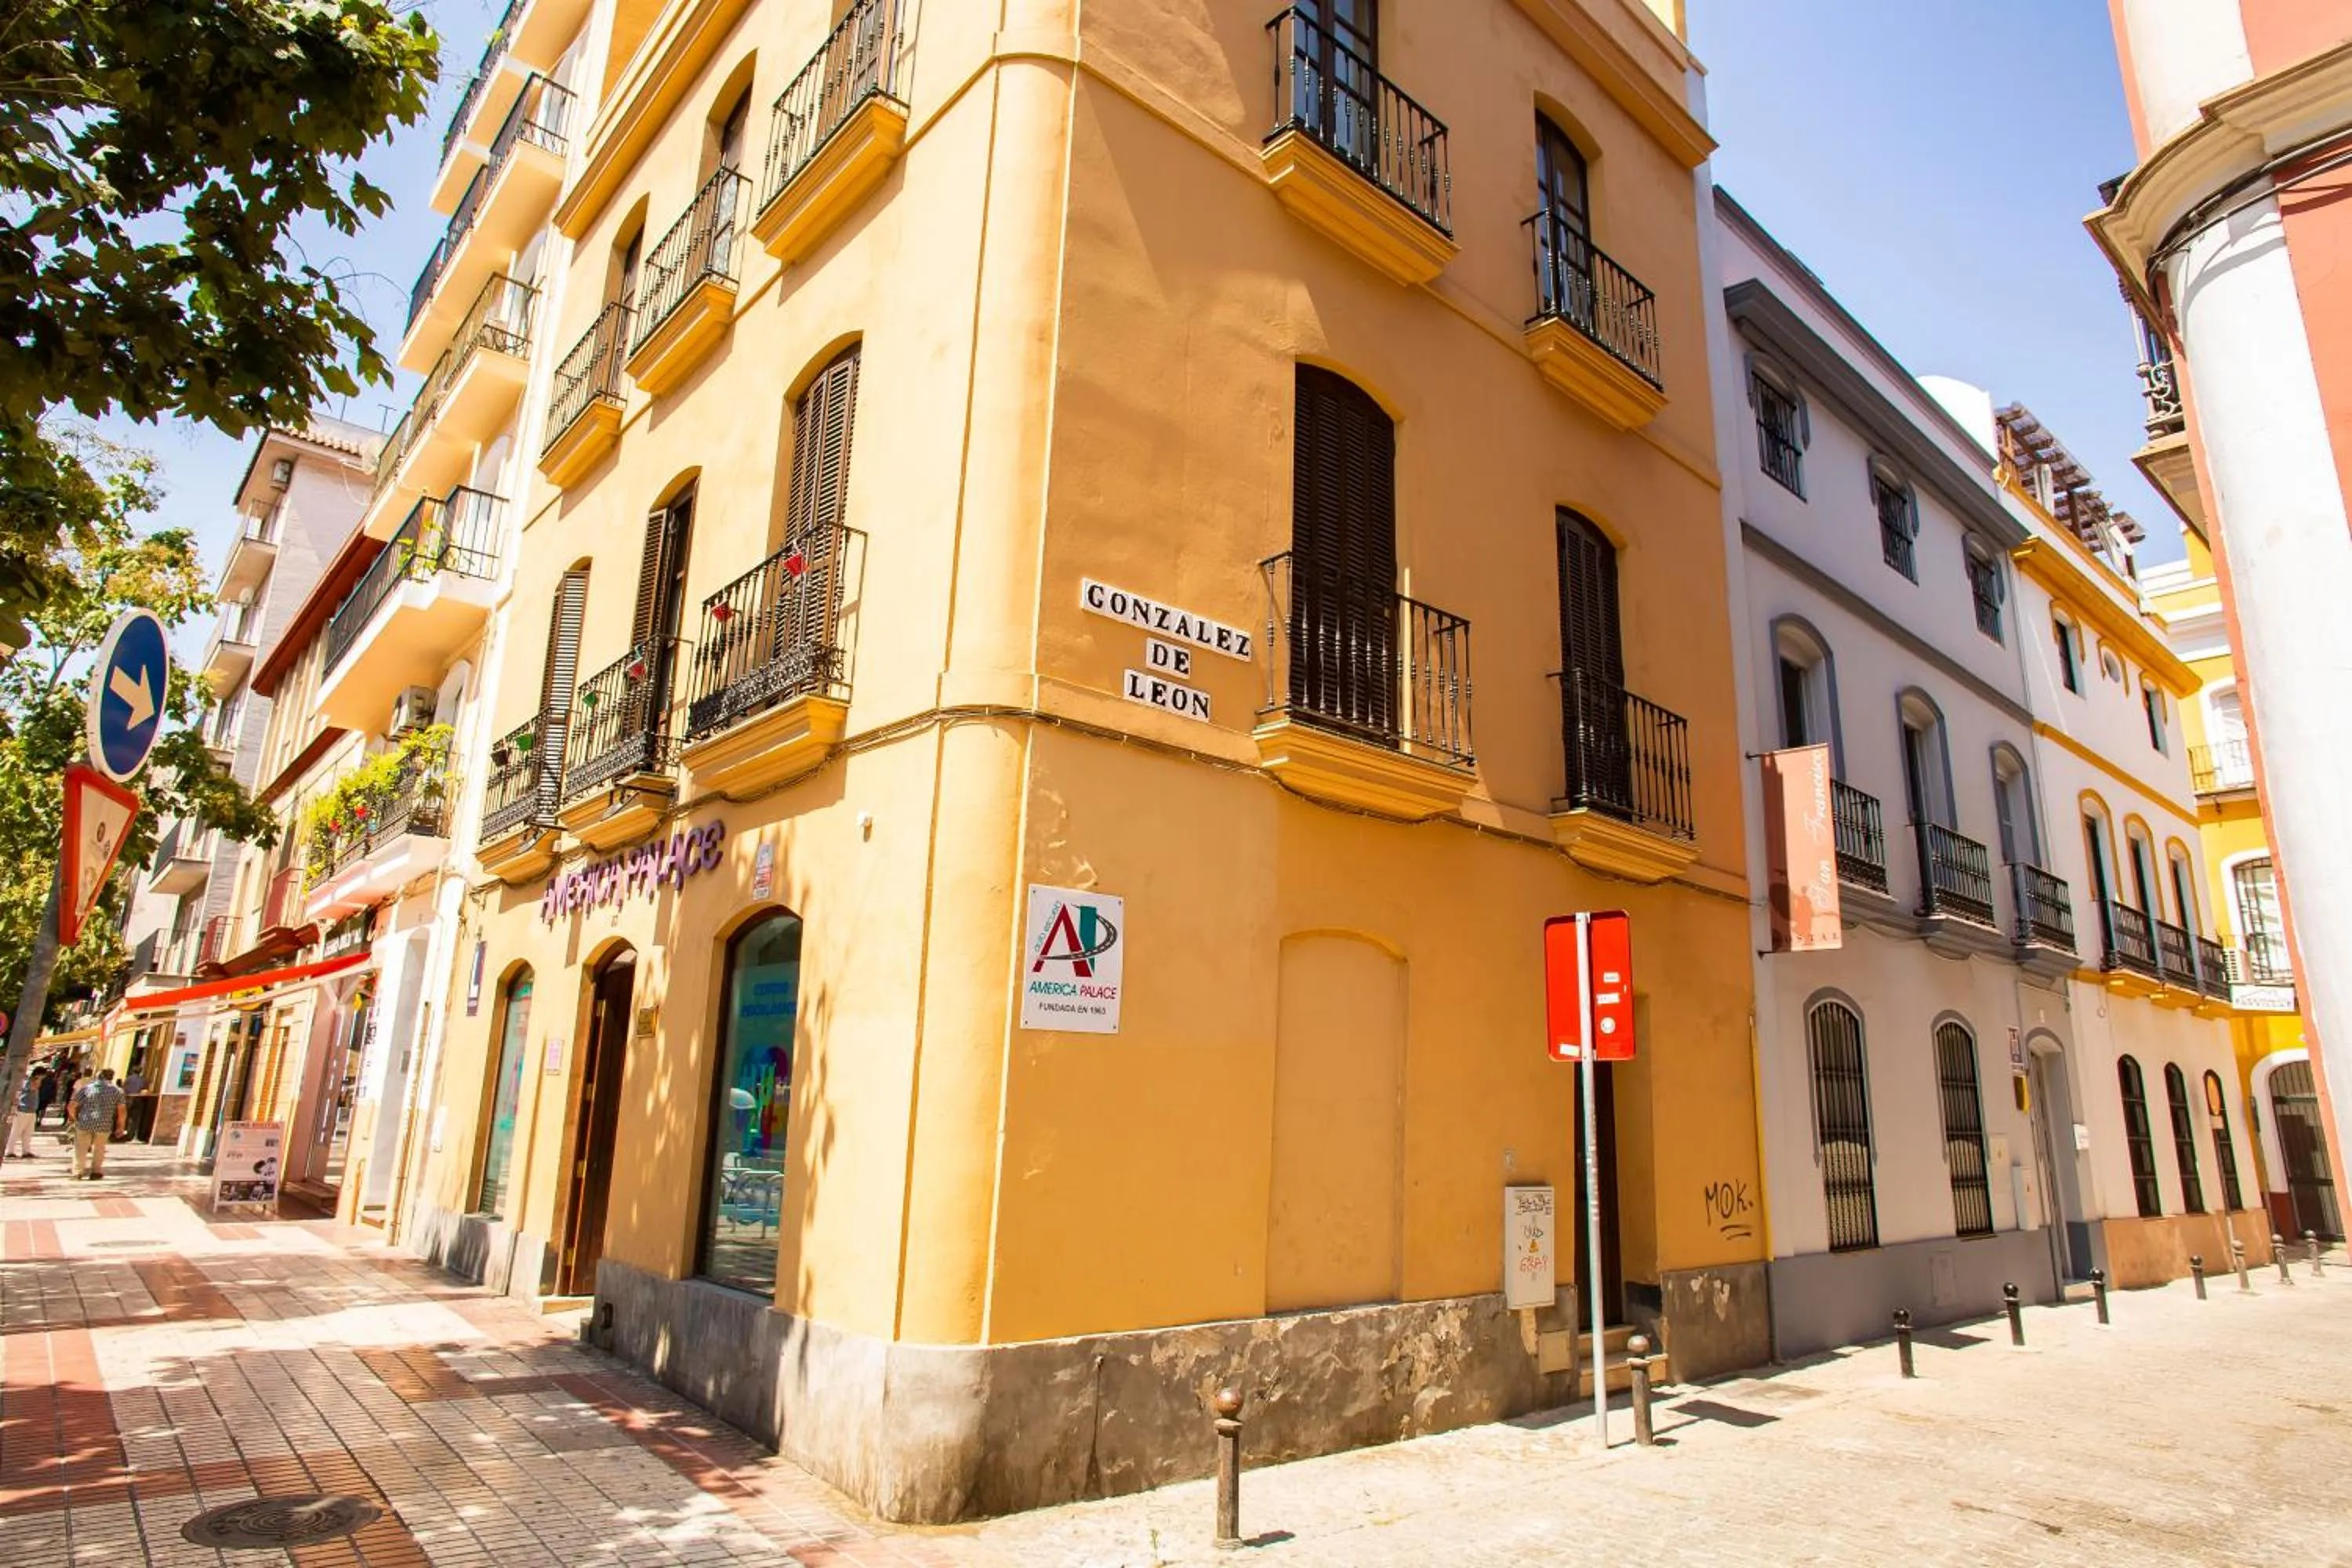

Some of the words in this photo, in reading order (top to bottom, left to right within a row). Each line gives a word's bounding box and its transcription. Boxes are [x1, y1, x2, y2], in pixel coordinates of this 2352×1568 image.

[1087, 583, 1251, 657] GONZALEZ
[1152, 643, 1190, 675] DE
[1128, 673, 1210, 719] LEON
[541, 857, 625, 924] AMERICA
[626, 820, 726, 898] PALACE
[1808, 858, 1831, 909] San
[1029, 981, 1077, 996] AMERICA
[1080, 984, 1117, 1000] PALACE
[1039, 1002, 1076, 1014] FUNDADA
[1077, 1006, 1088, 1014] EN
